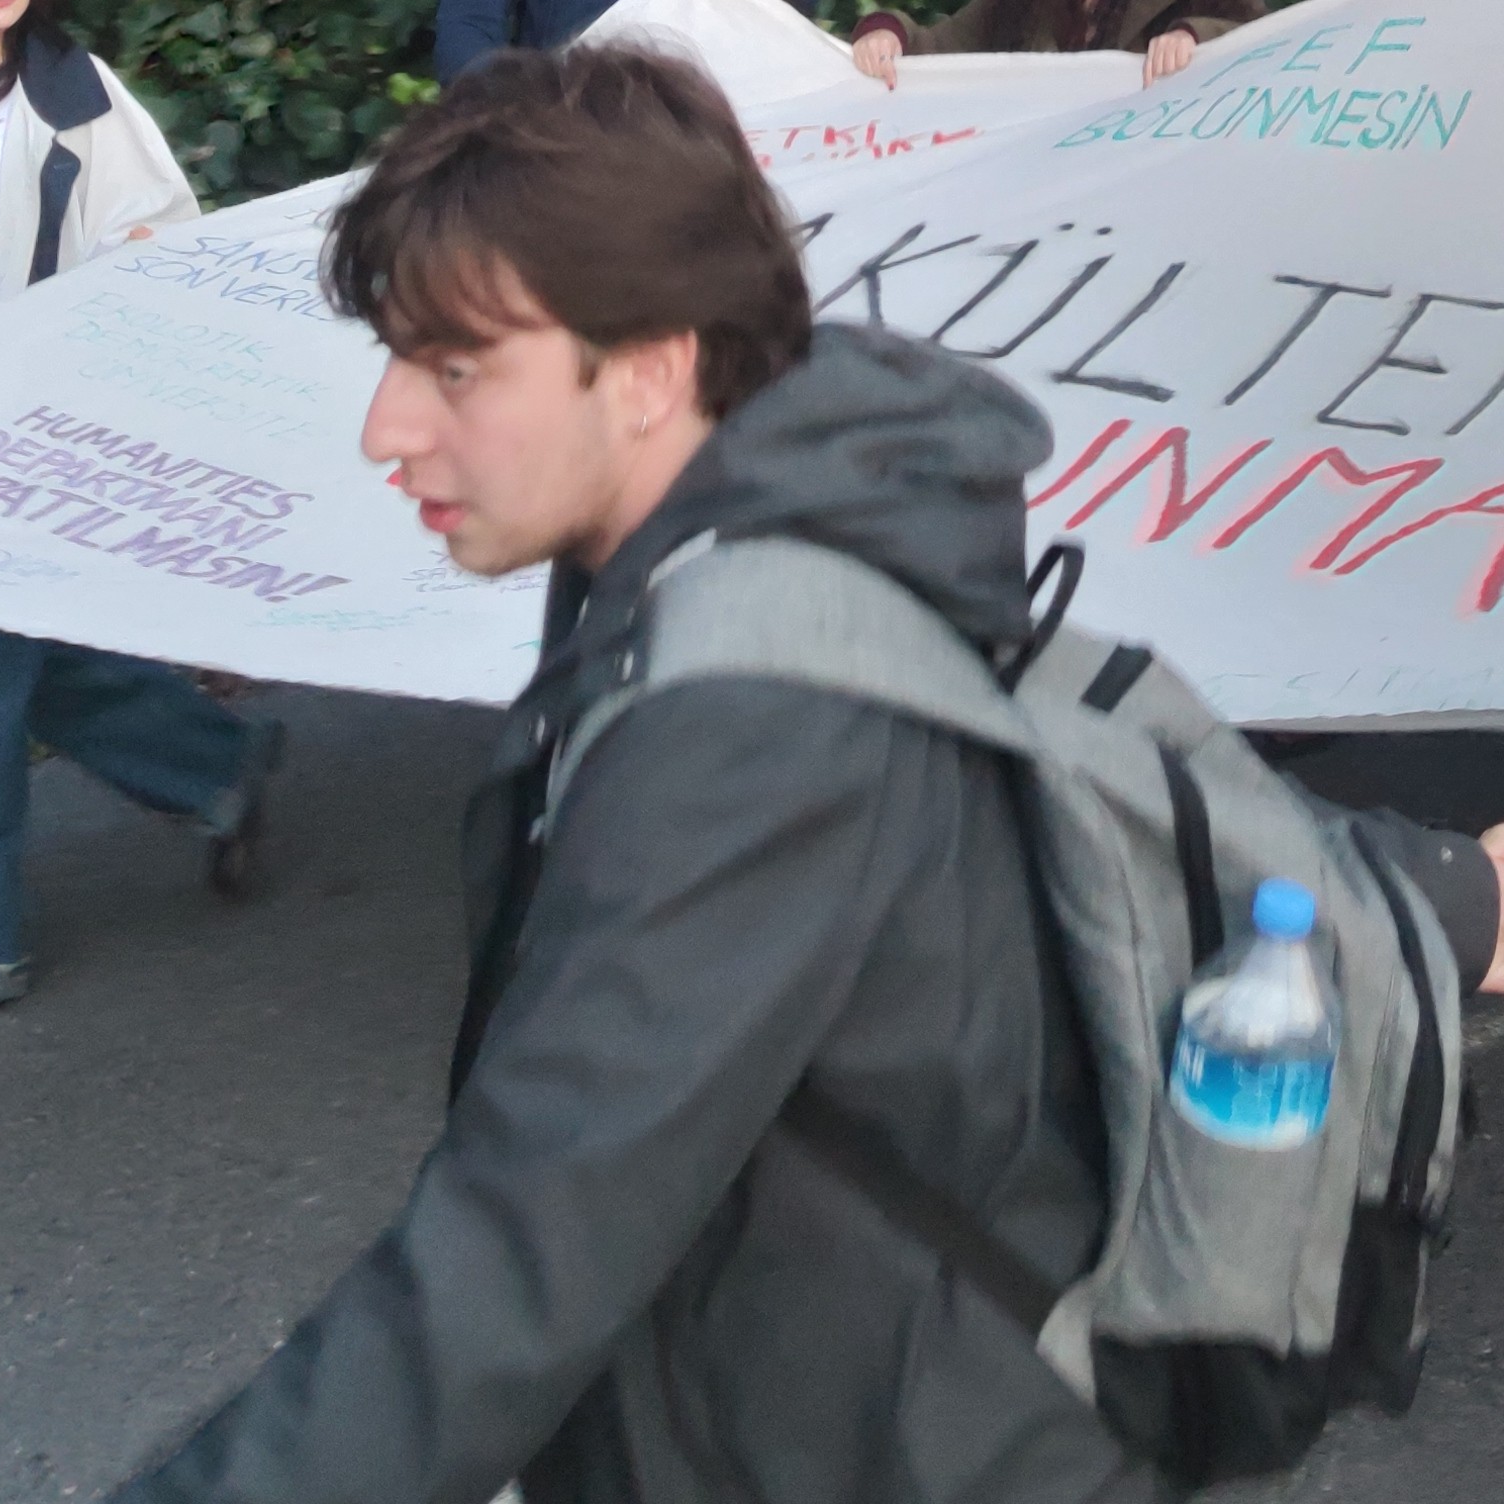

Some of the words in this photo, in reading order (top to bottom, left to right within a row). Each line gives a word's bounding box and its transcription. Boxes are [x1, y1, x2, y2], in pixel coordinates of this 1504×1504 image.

[1200, 15, 1427, 89] FEF
[113, 256, 228, 290] SON
[13, 404, 315, 521] HUMANITIES
